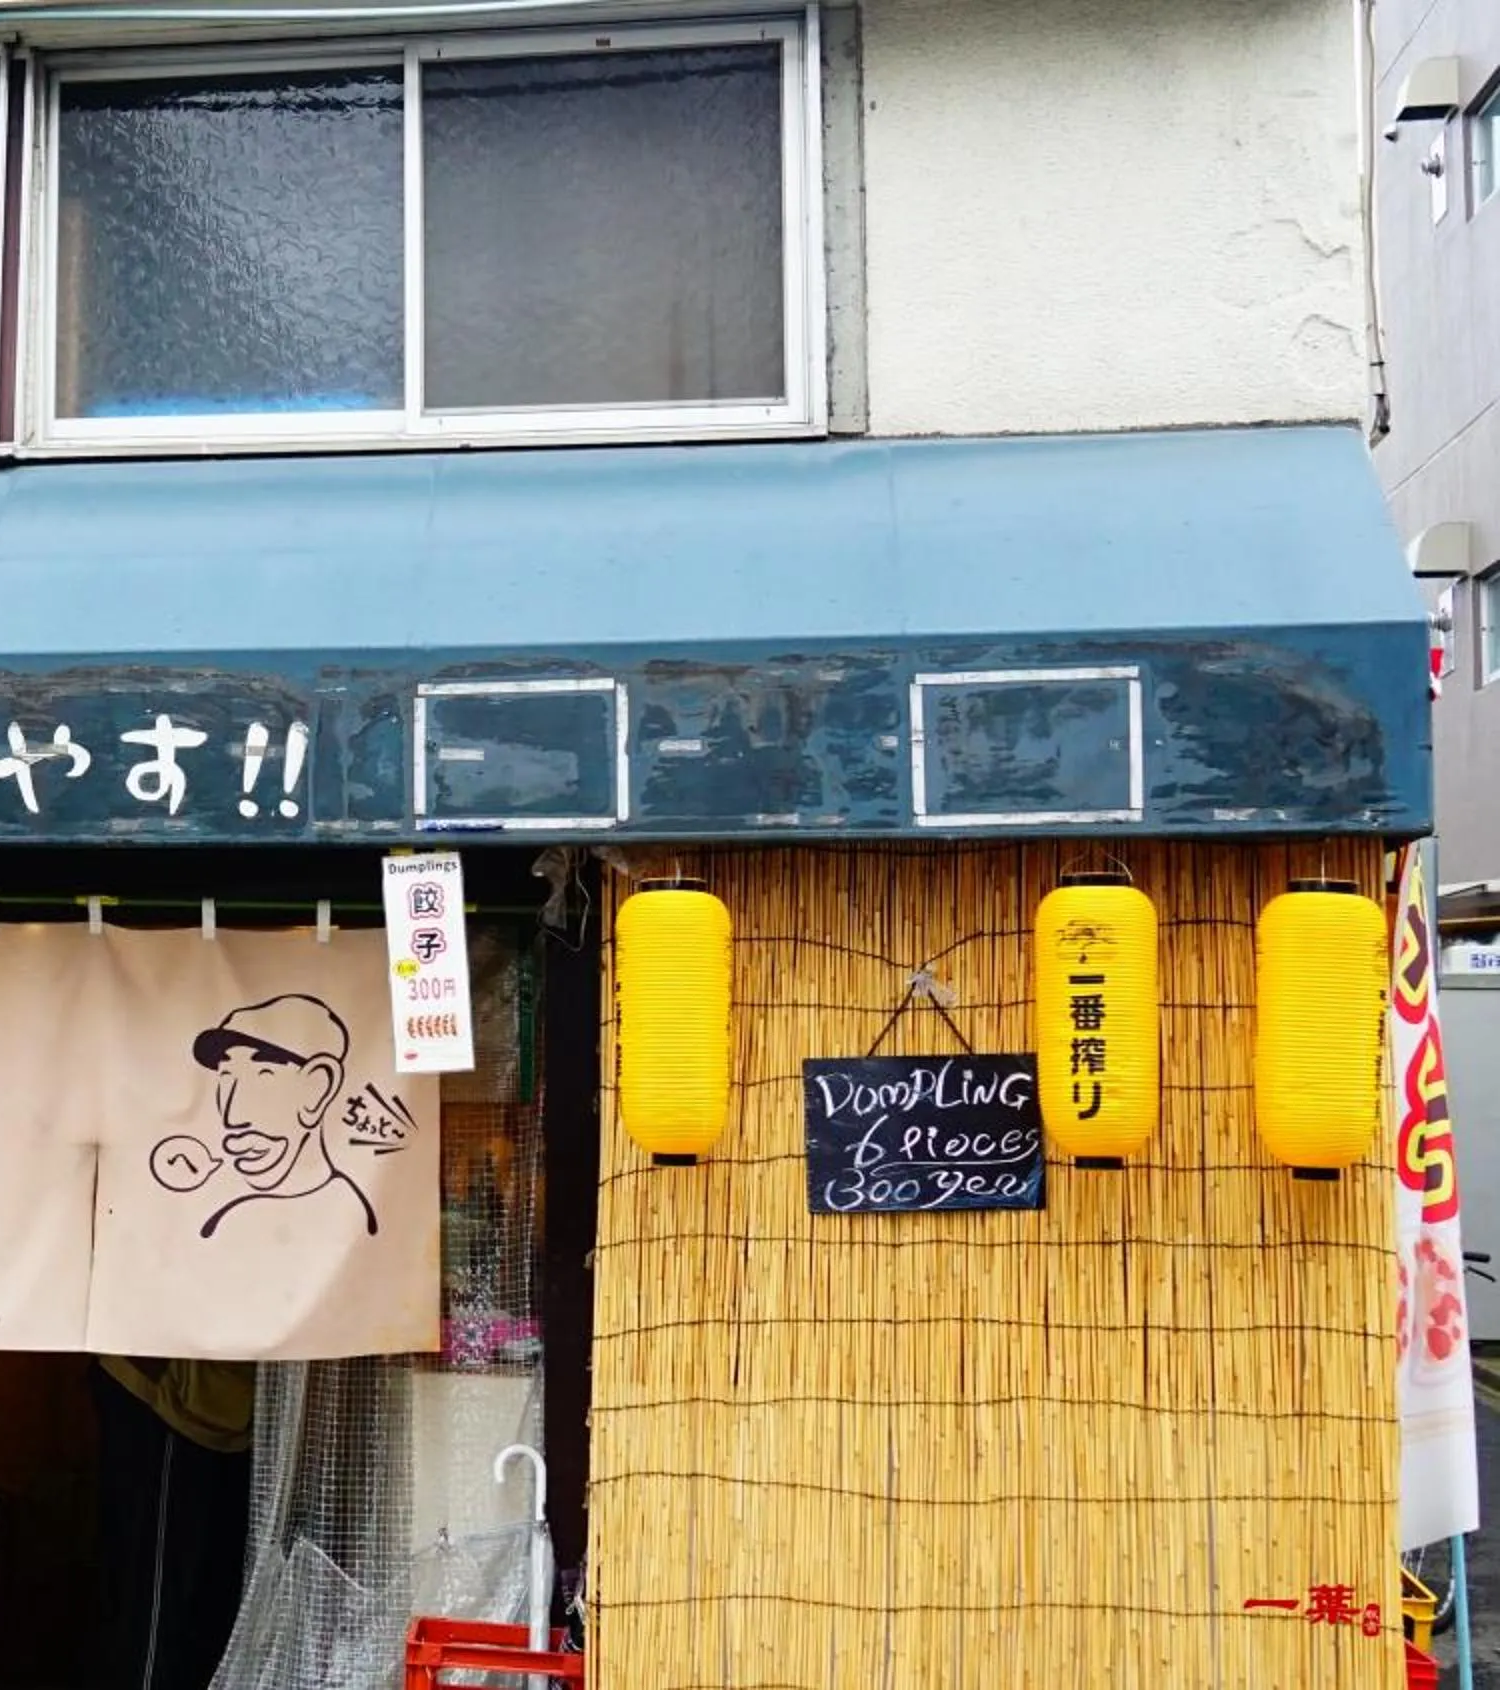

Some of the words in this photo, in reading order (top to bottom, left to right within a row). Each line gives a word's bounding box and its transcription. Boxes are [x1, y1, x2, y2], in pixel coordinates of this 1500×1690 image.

[387, 859, 458, 875] Dumplings
[411, 885, 443, 961] 餃子
[408, 977, 456, 1001] 300円
[1068, 973, 1106, 1120] 一番搾り
[845, 1114, 889, 1168] 6
[167, 1152, 199, 1175] へ
